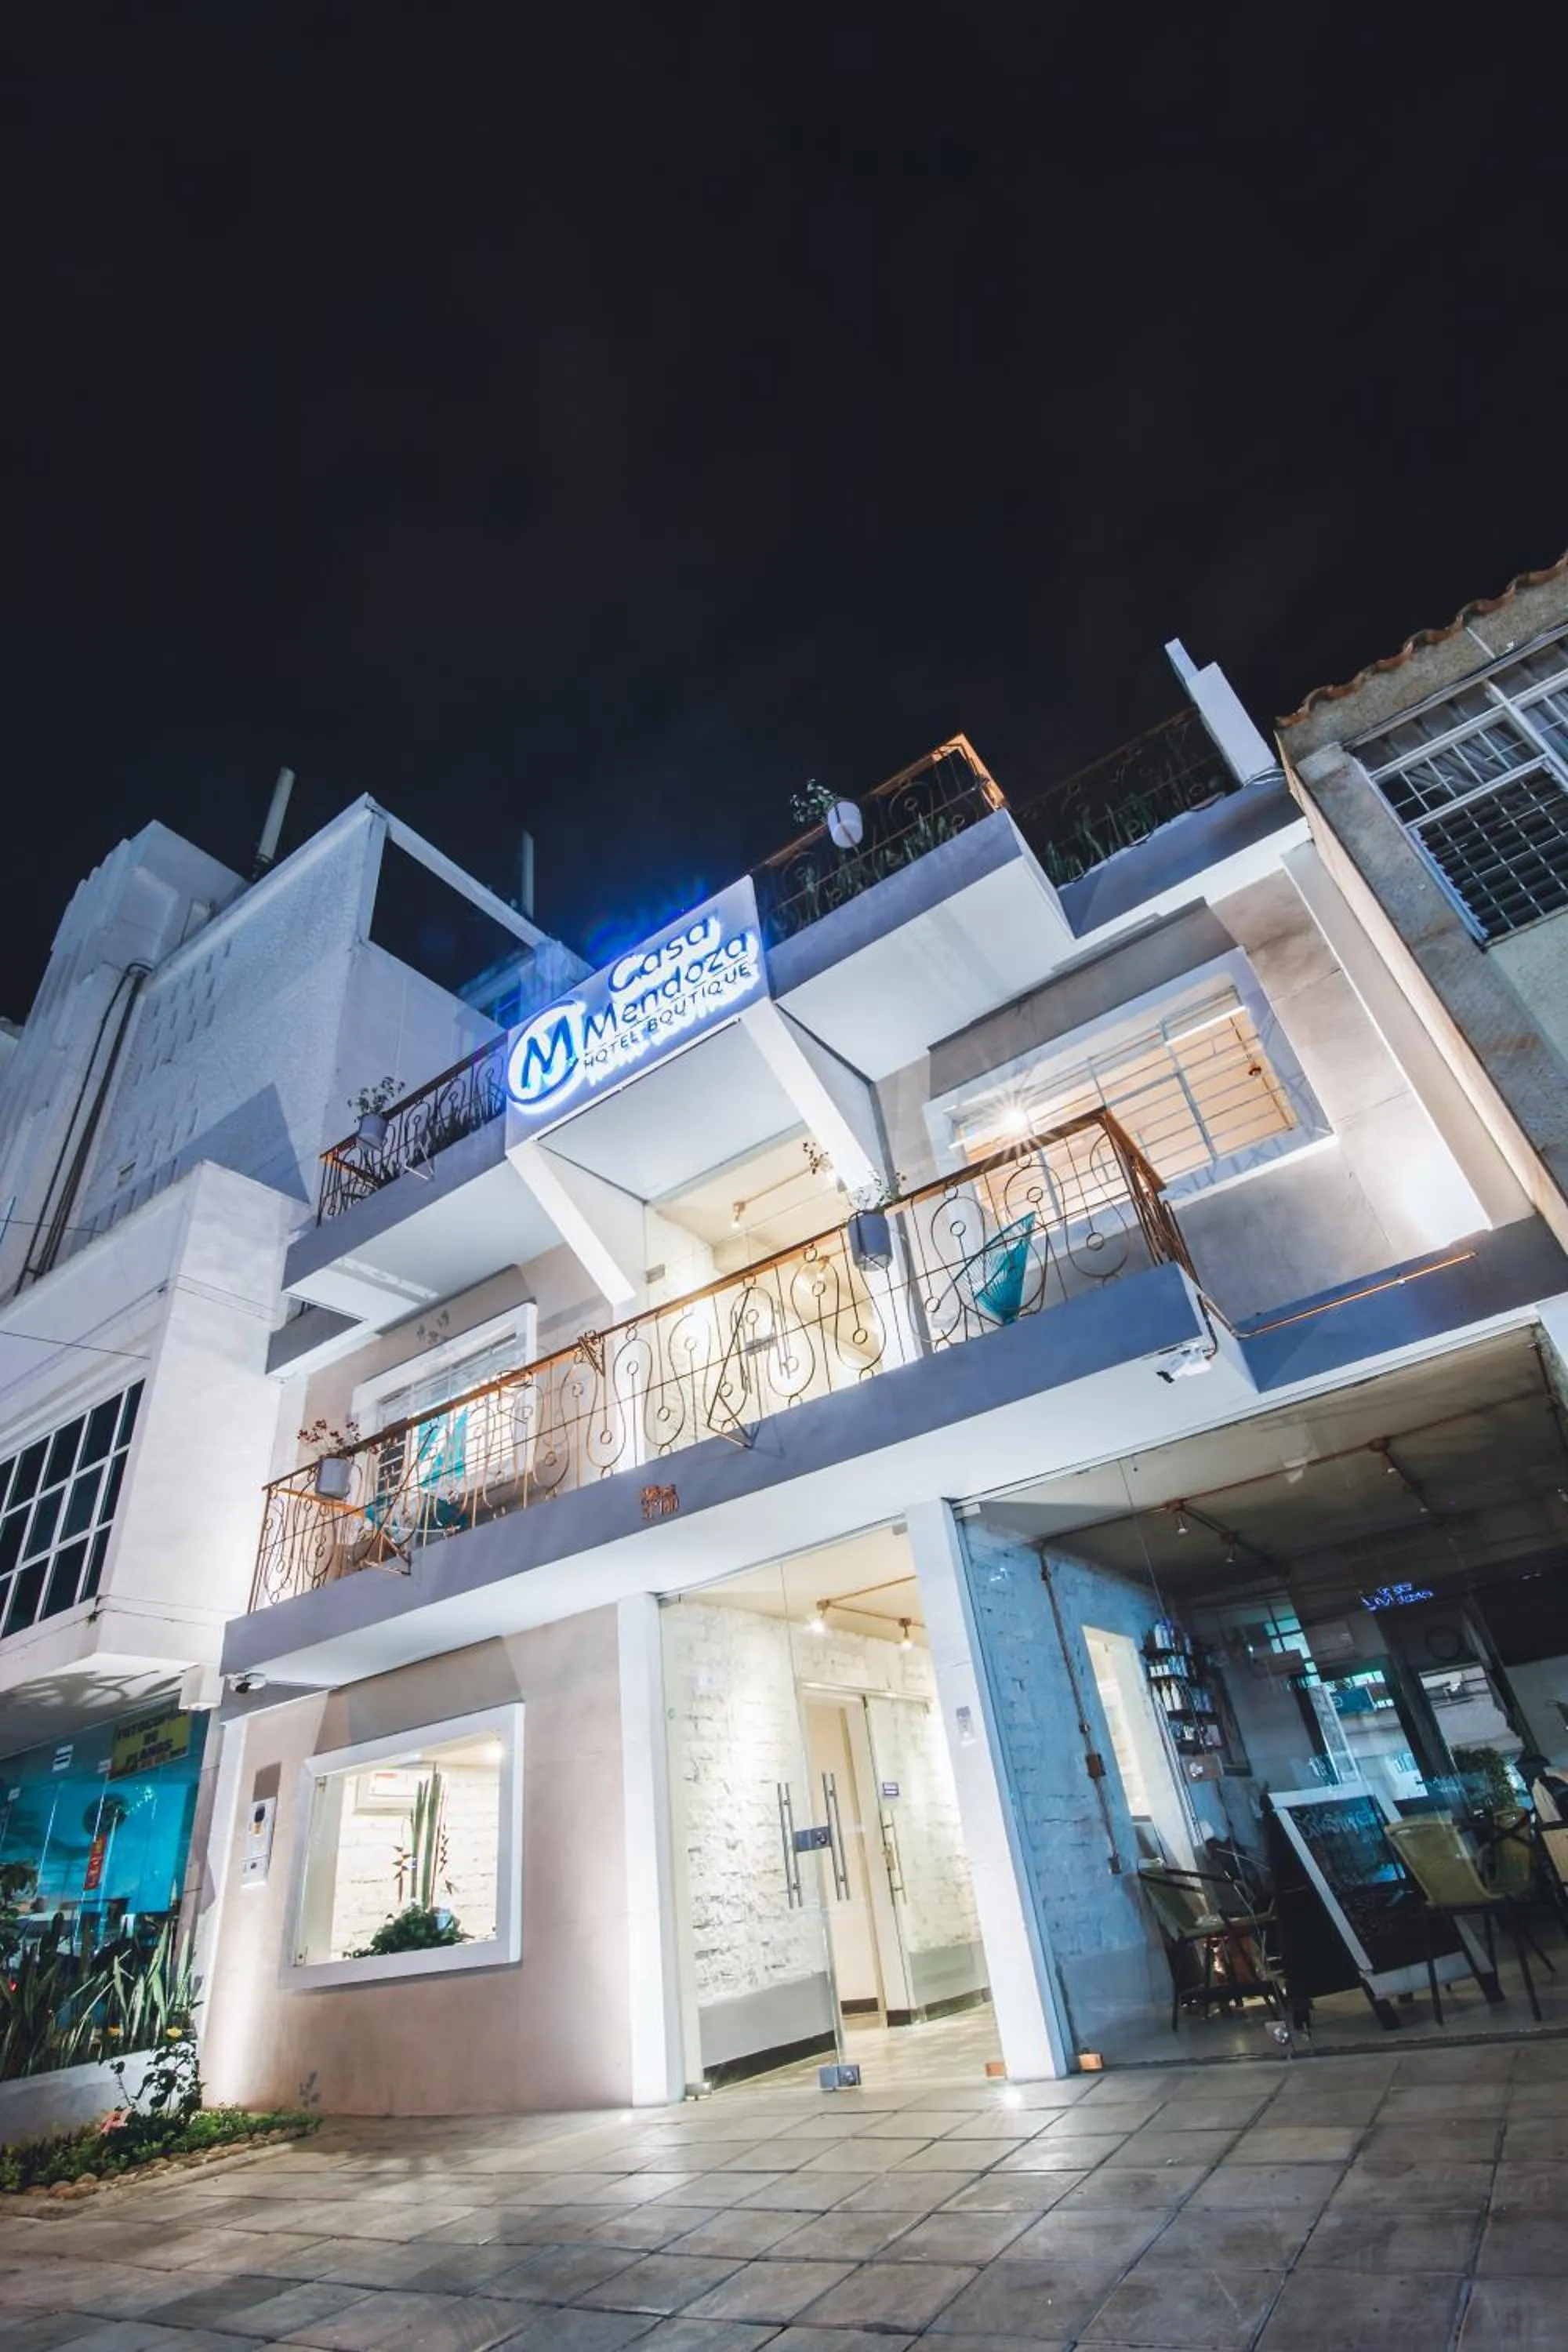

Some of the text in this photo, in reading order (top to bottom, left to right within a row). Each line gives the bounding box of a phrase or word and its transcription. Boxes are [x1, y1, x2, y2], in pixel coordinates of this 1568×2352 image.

[583, 932, 747, 1050] Mendoza
[608, 917, 709, 993] Casa
[583, 961, 752, 1069] HOTEL BOUTIQUE
